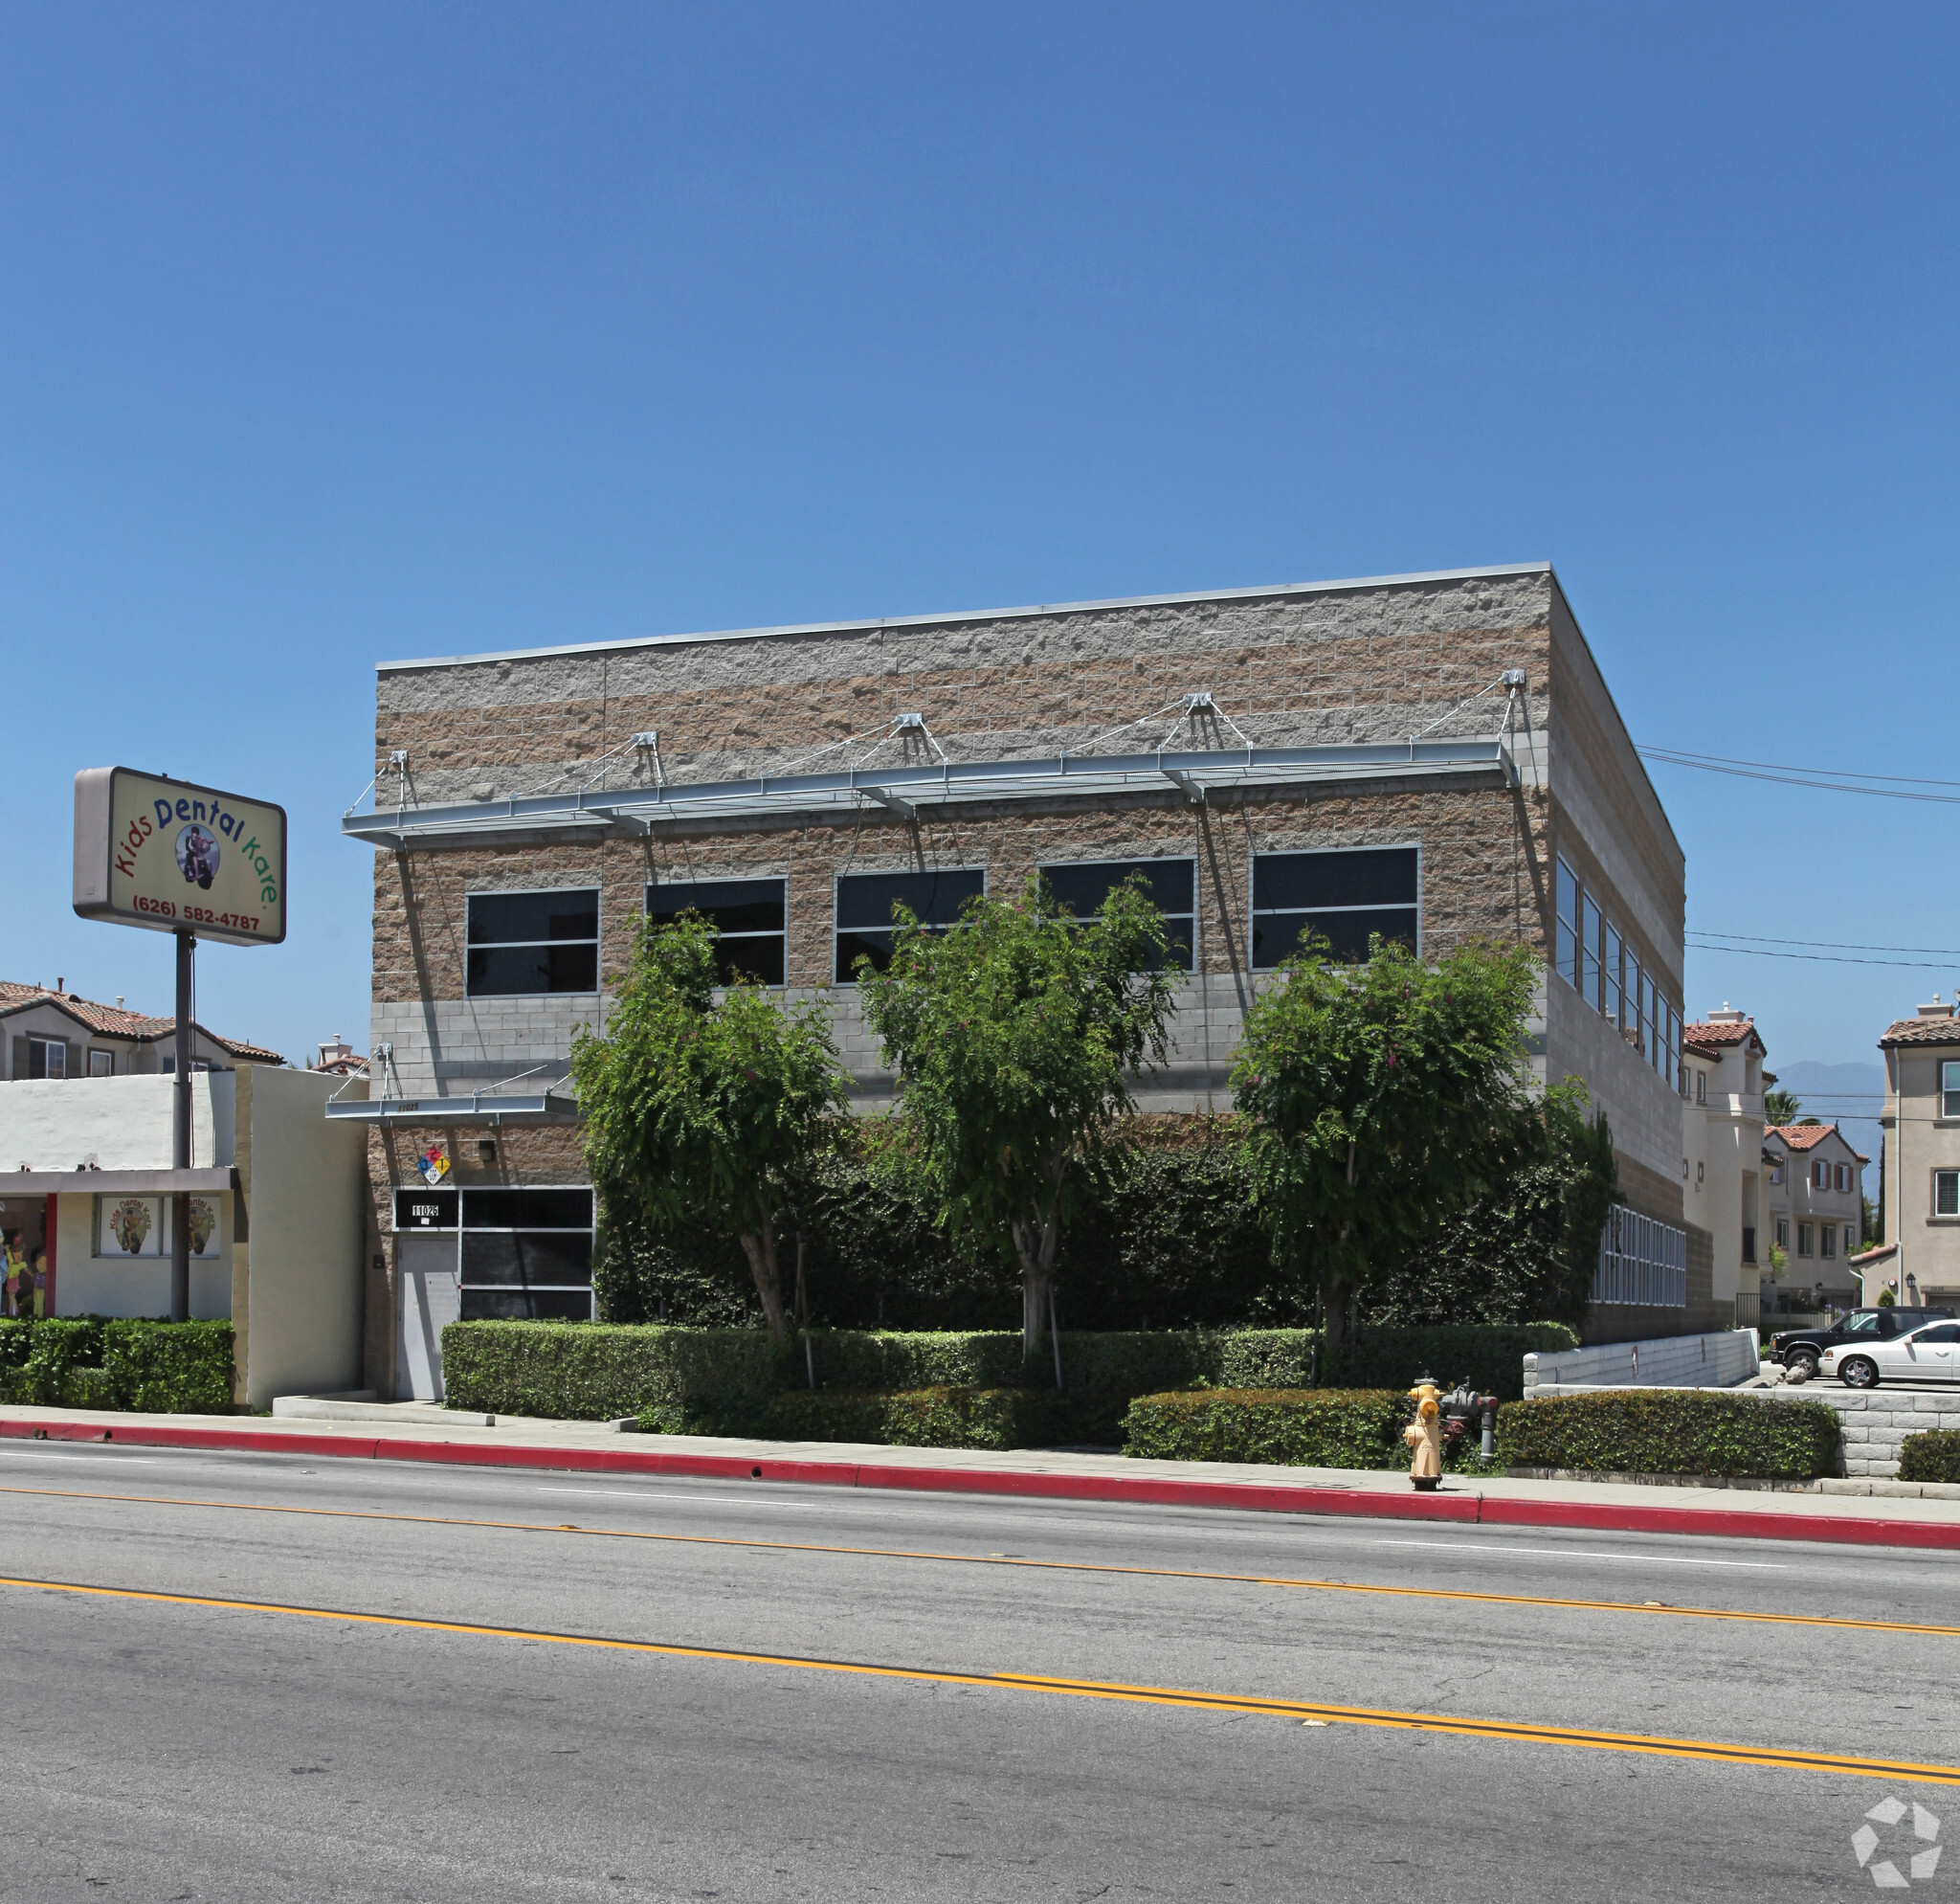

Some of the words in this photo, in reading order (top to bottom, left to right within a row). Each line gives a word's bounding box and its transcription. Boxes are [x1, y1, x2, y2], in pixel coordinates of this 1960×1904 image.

[115, 816, 152, 878] Kids
[154, 797, 245, 842] Dental
[241, 836, 278, 904] Kare
[133, 895, 176, 918] (626)
[184, 905, 260, 931] 582-4787
[398, 1102, 419, 1112] 11025
[430, 1147, 437, 1159] 2
[421, 1158, 429, 1171] 3
[440, 1158, 444, 1171] 1
[189, 1198, 208, 1209] ental
[110, 1209, 121, 1229] Kids
[120, 1198, 144, 1210] Dental
